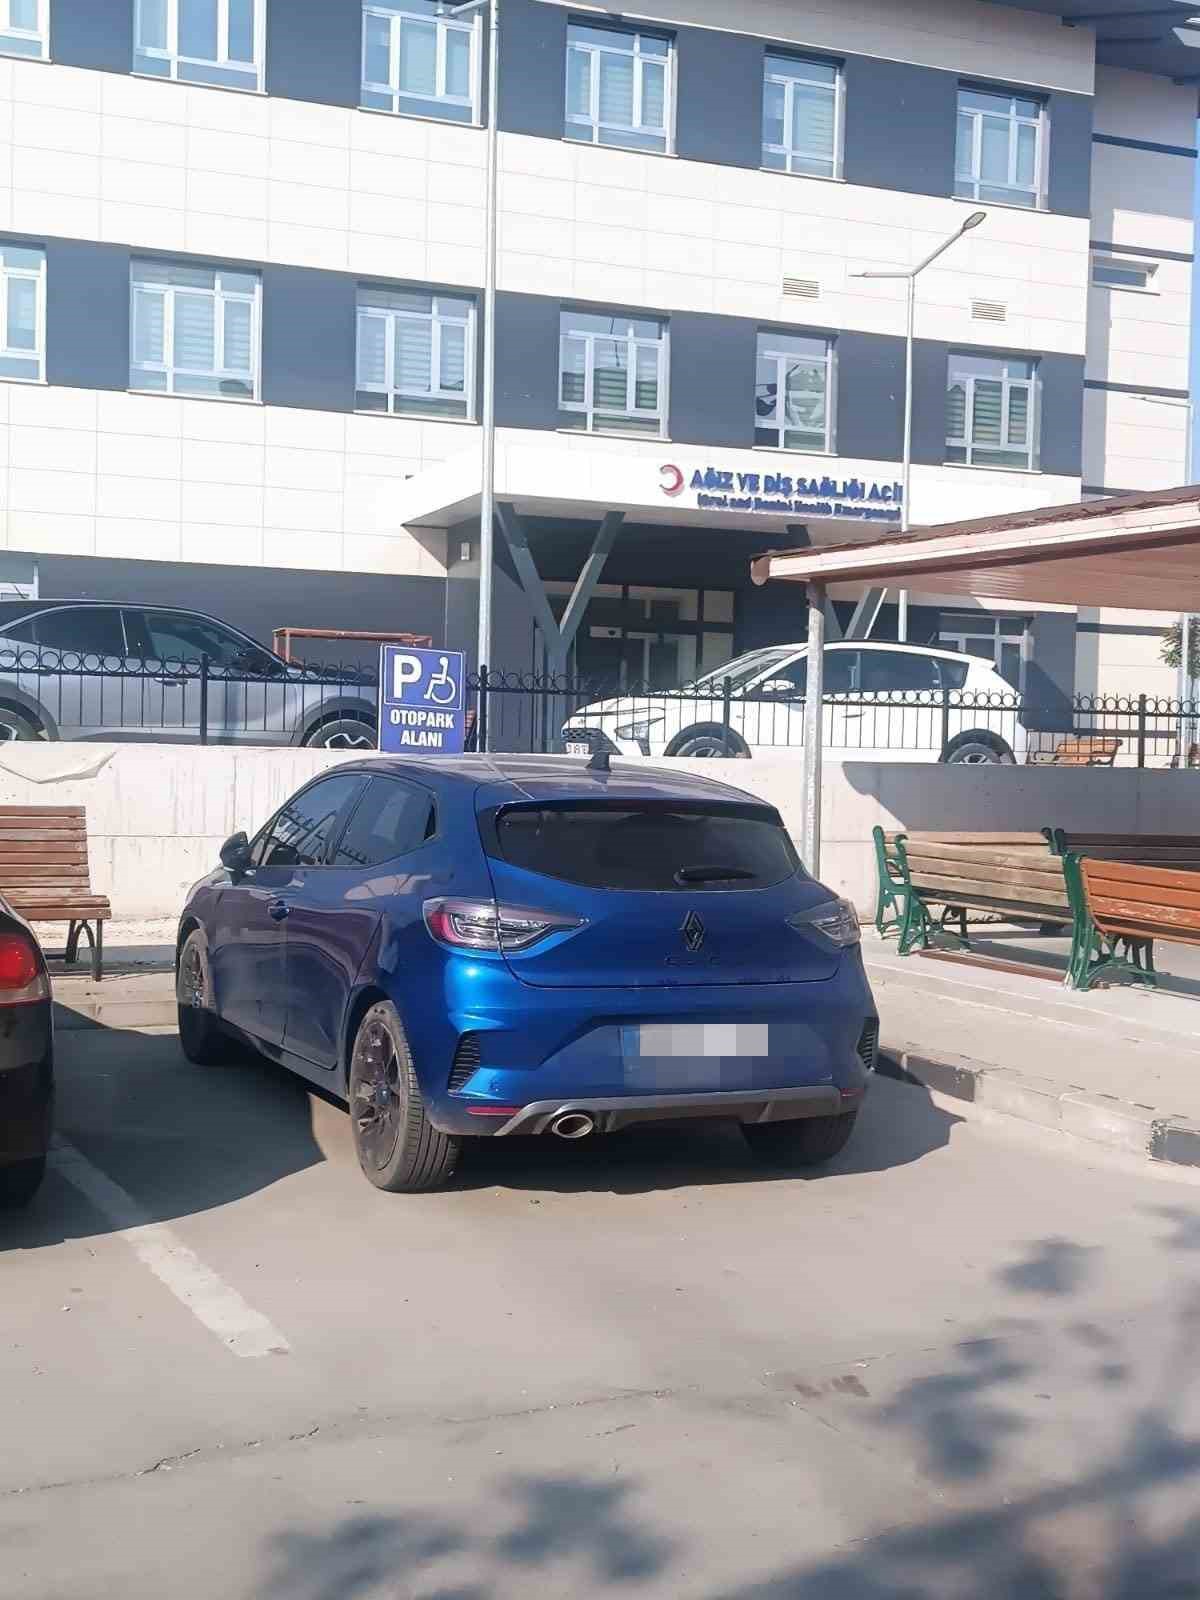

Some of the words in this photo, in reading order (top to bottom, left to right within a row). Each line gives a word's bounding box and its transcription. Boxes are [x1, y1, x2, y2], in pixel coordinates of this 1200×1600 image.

[690, 467, 733, 490] AĞIZ
[736, 473, 760, 492] VE
[764, 473, 793, 497] DİŞ
[795, 476, 865, 500] SAĞLIĞI
[393, 654, 422, 699] P
[390, 708, 455, 729] OTOPARK
[400, 729, 443, 748] ALANI
